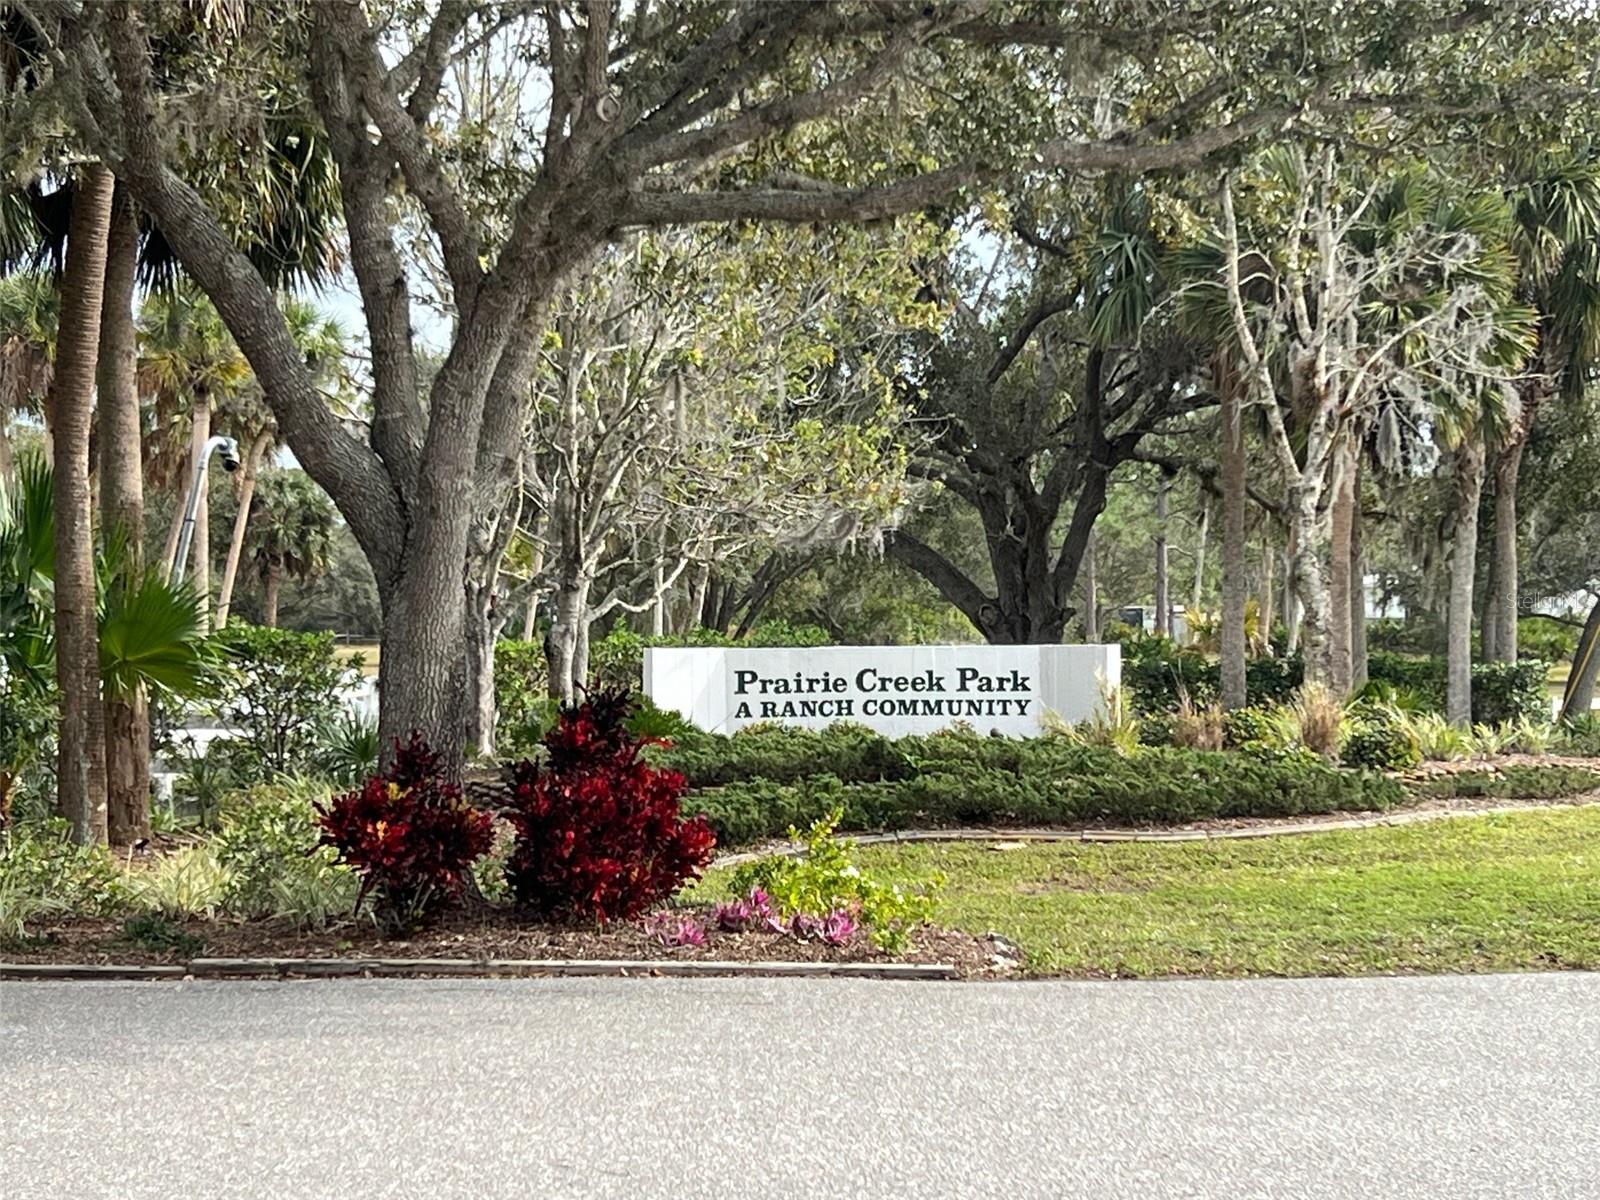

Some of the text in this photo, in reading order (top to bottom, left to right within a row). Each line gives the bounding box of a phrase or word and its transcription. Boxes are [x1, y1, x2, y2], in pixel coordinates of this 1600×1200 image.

[734, 667, 1031, 695] Prairie Creek Park
[735, 699, 1031, 718] A RANCH COMMUNITY
